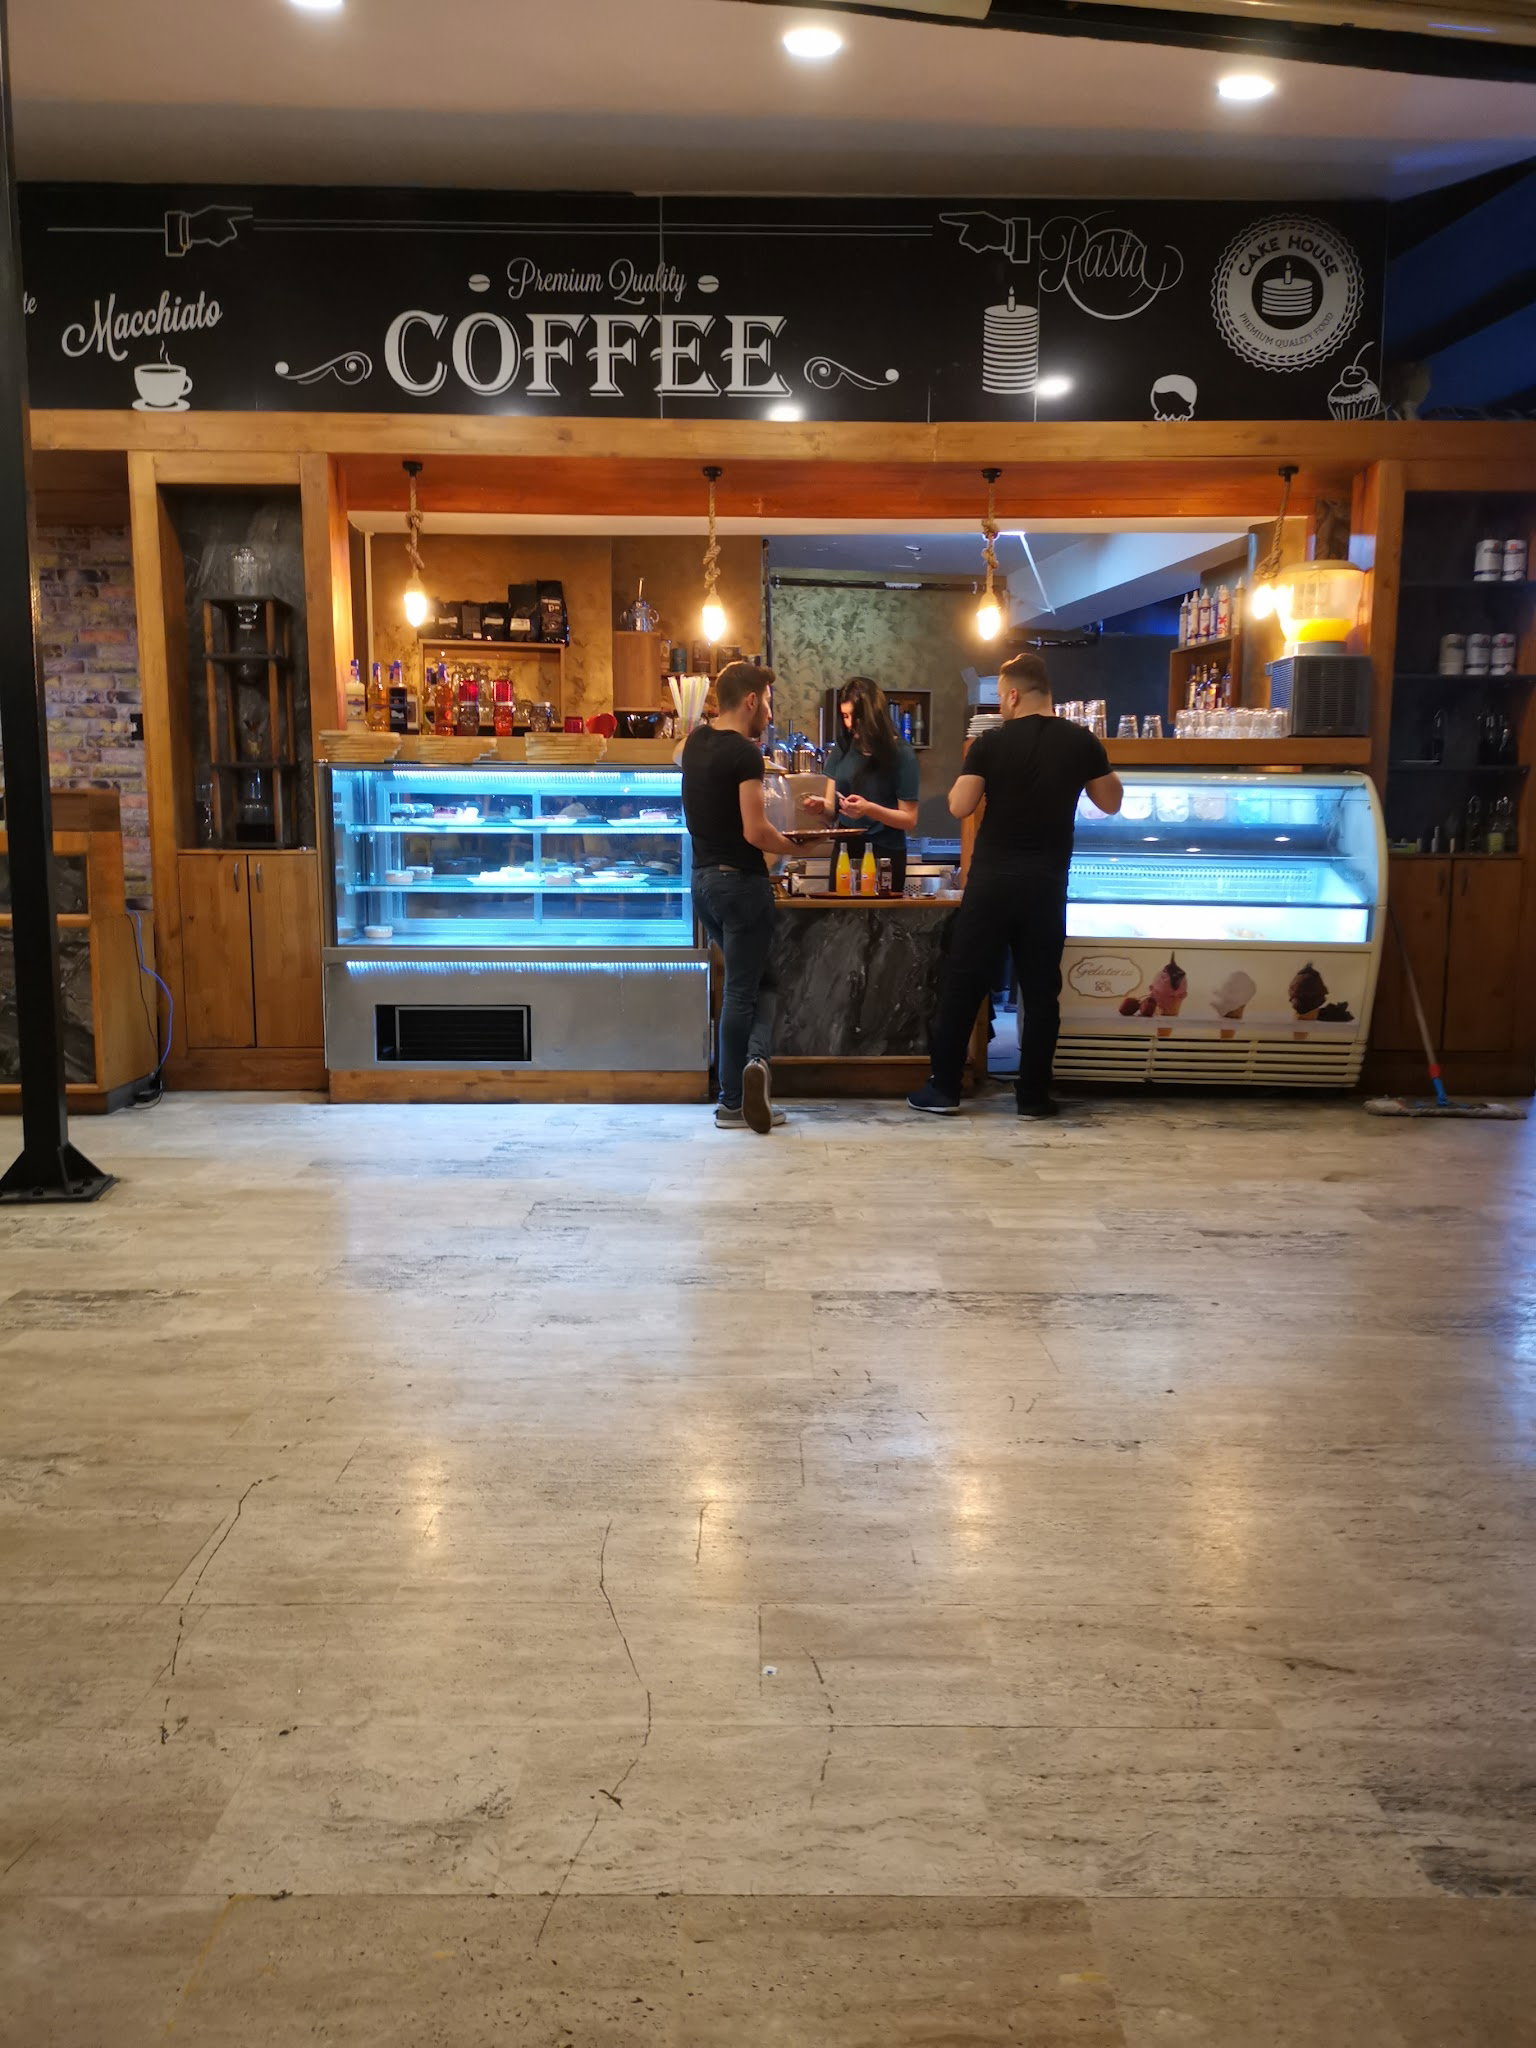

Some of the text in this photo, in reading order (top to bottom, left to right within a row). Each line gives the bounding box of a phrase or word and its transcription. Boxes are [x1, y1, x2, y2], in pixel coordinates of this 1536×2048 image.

[1239, 235, 1339, 277] CAKE HOUSE
[507, 257, 687, 305] Premium Quality
[61, 290, 223, 362] Macchiato
[1239, 312, 1334, 348] PREMIUM QUALITY FOOD
[384, 309, 793, 397] COFFEE
